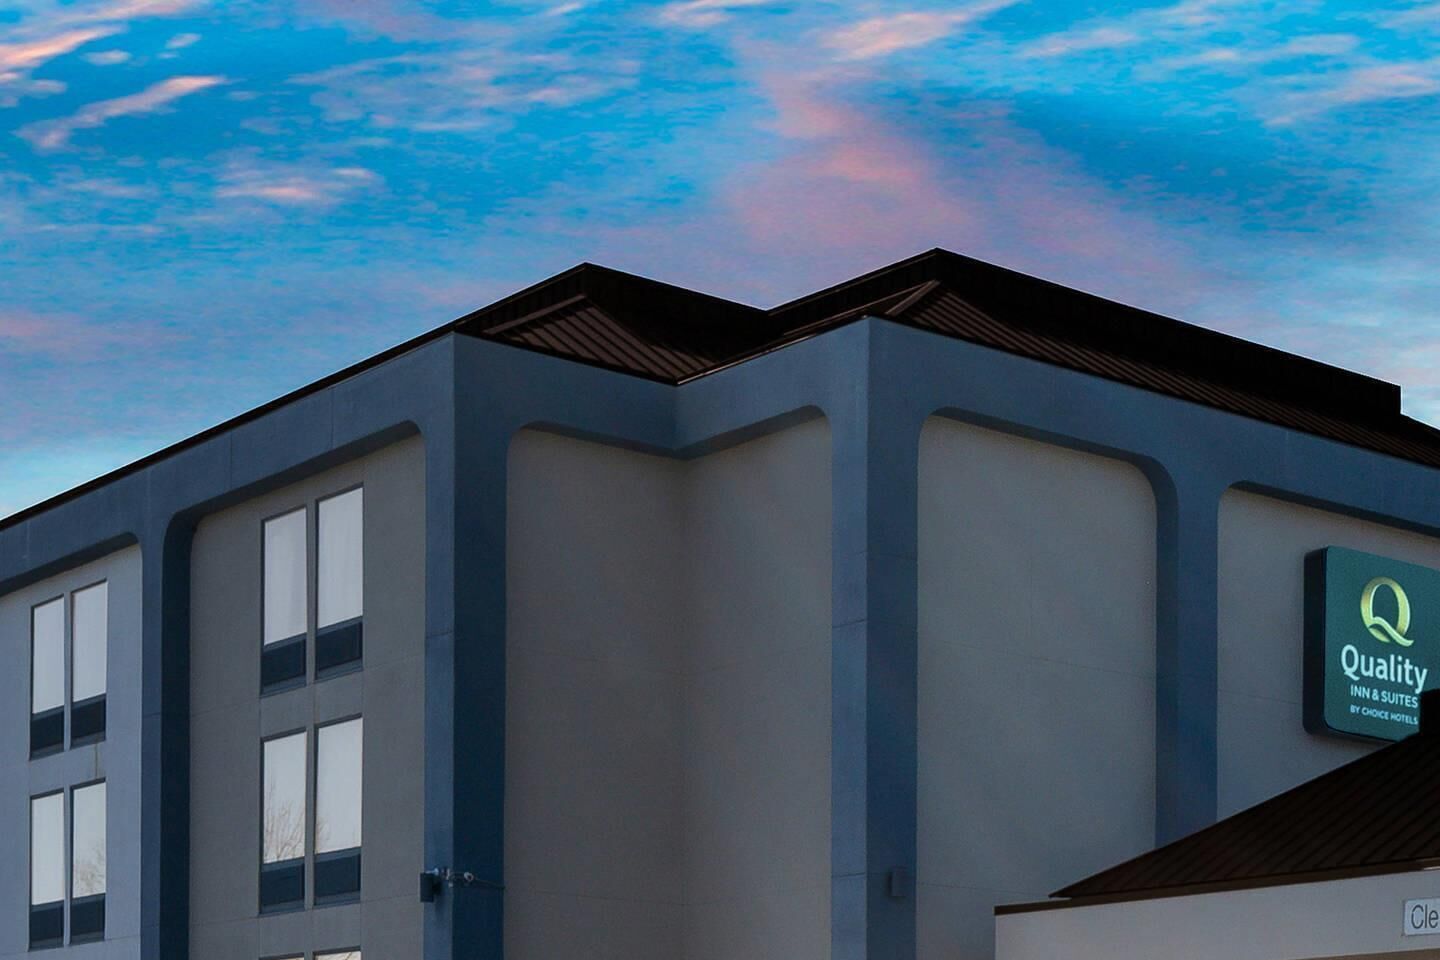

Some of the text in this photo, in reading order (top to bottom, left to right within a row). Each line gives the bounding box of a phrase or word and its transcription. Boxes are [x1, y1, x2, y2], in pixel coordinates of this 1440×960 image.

[1360, 576, 1415, 647] Q
[1341, 644, 1428, 694] Quality
[1350, 685, 1418, 708] INN & SUITES
[1350, 704, 1418, 725] BY CHOICE HOTELS
